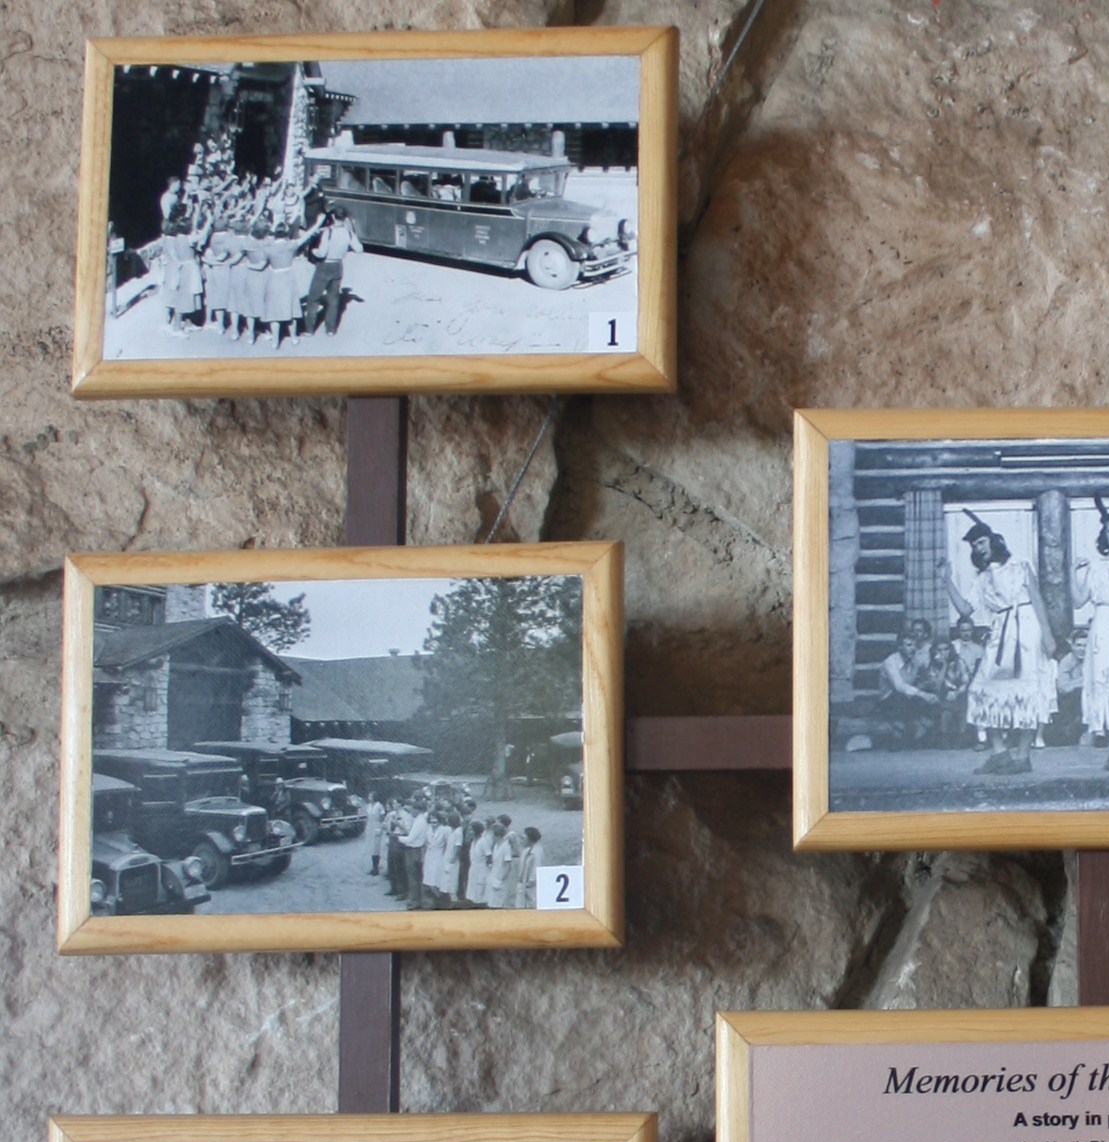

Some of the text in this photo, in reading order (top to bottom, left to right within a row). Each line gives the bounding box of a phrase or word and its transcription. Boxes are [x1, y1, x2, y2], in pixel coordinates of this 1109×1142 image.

[608, 319, 618, 346] 1
[555, 873, 569, 903] 2
[882, 1066, 1038, 1094] Memories
[1047, 1063, 1086, 1100] of
[1014, 1113, 1028, 1127] A
[1033, 1113, 1080, 1130] story
[1086, 1111, 1102, 1126] in
